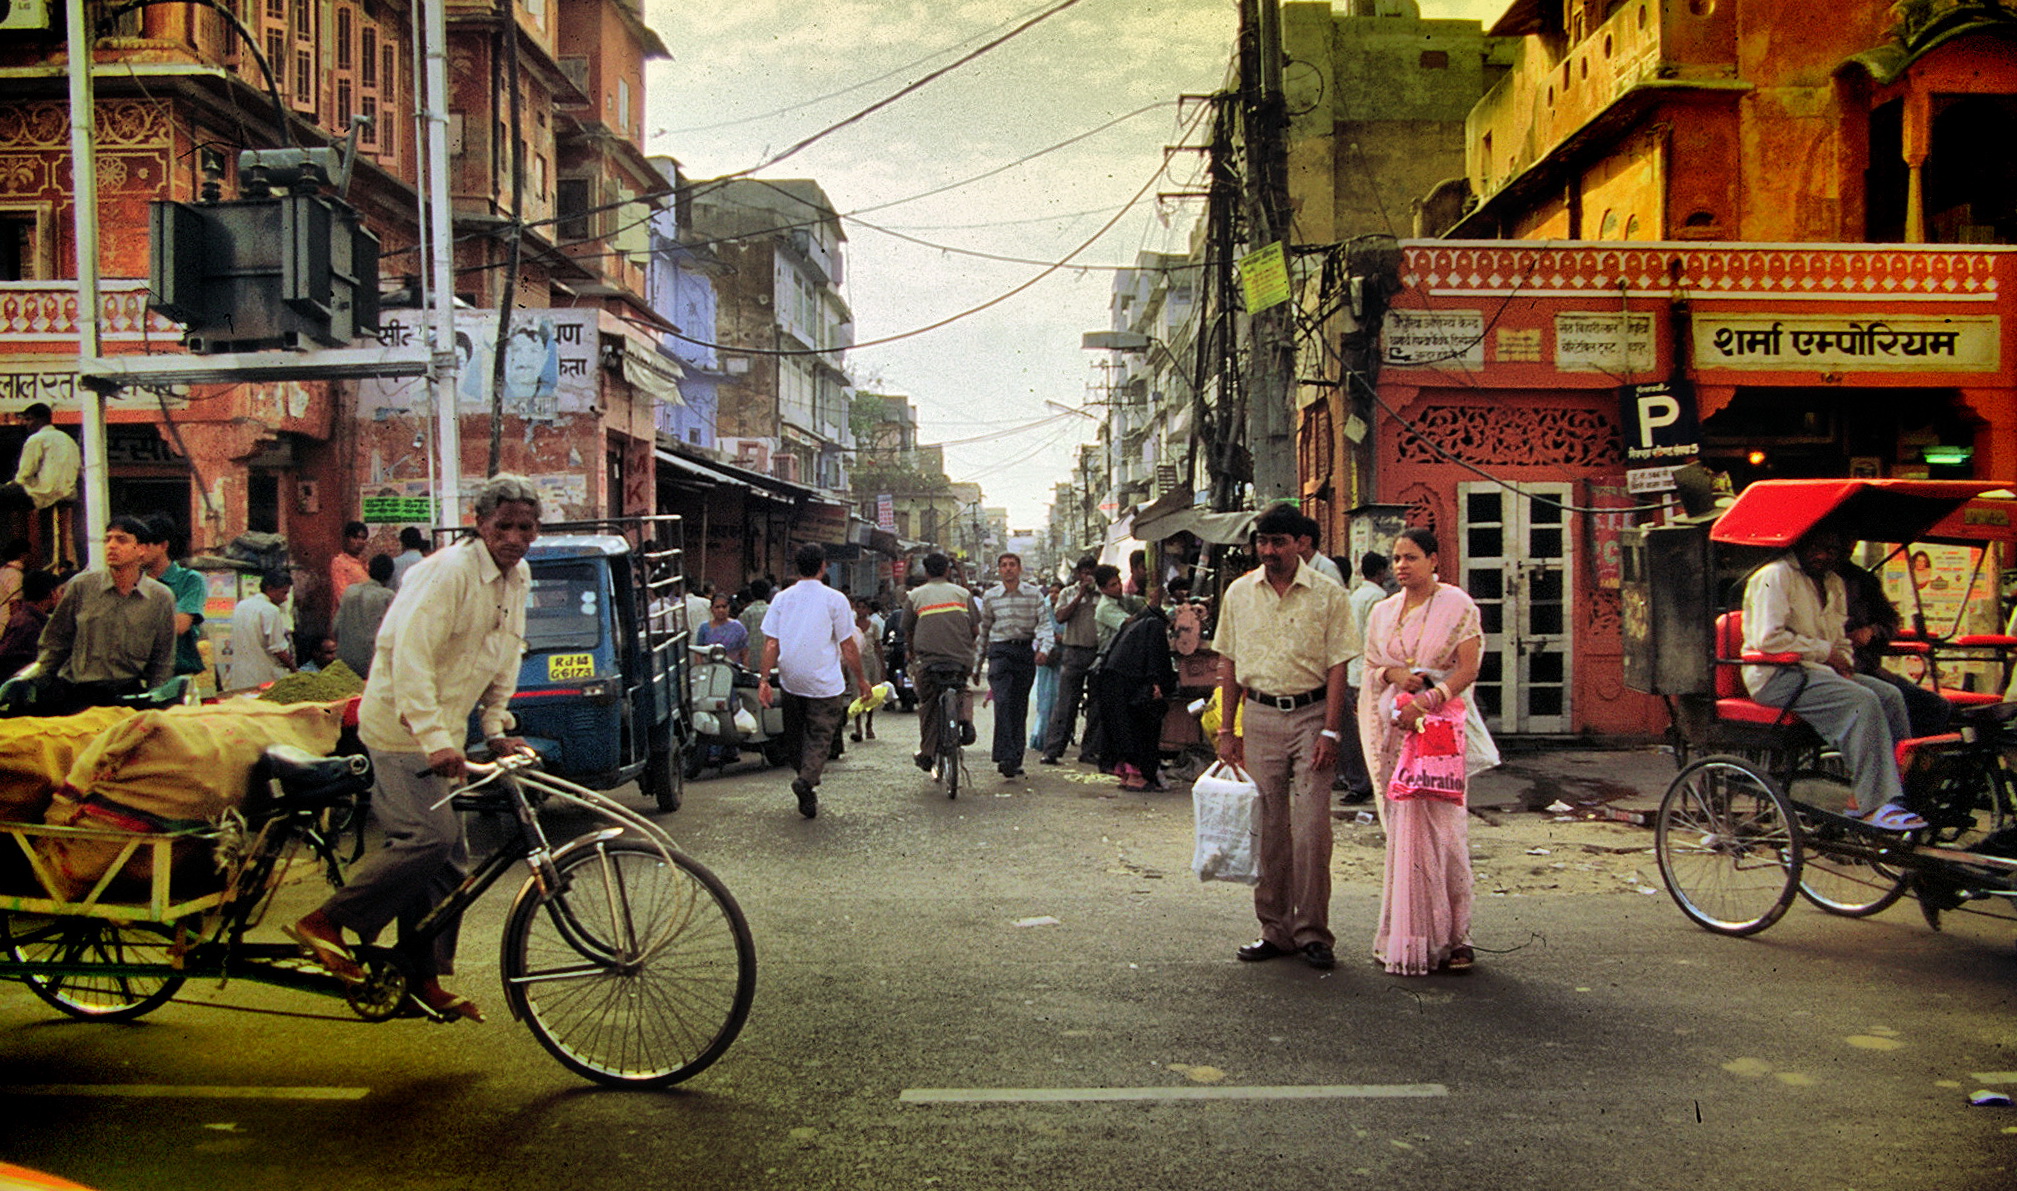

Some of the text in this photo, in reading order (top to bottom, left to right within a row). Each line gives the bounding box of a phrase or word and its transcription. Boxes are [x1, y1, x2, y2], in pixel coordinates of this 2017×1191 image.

[1714, 322, 1960, 357] शर्मा एम्पोरियम
[1637, 395, 1680, 448] P
